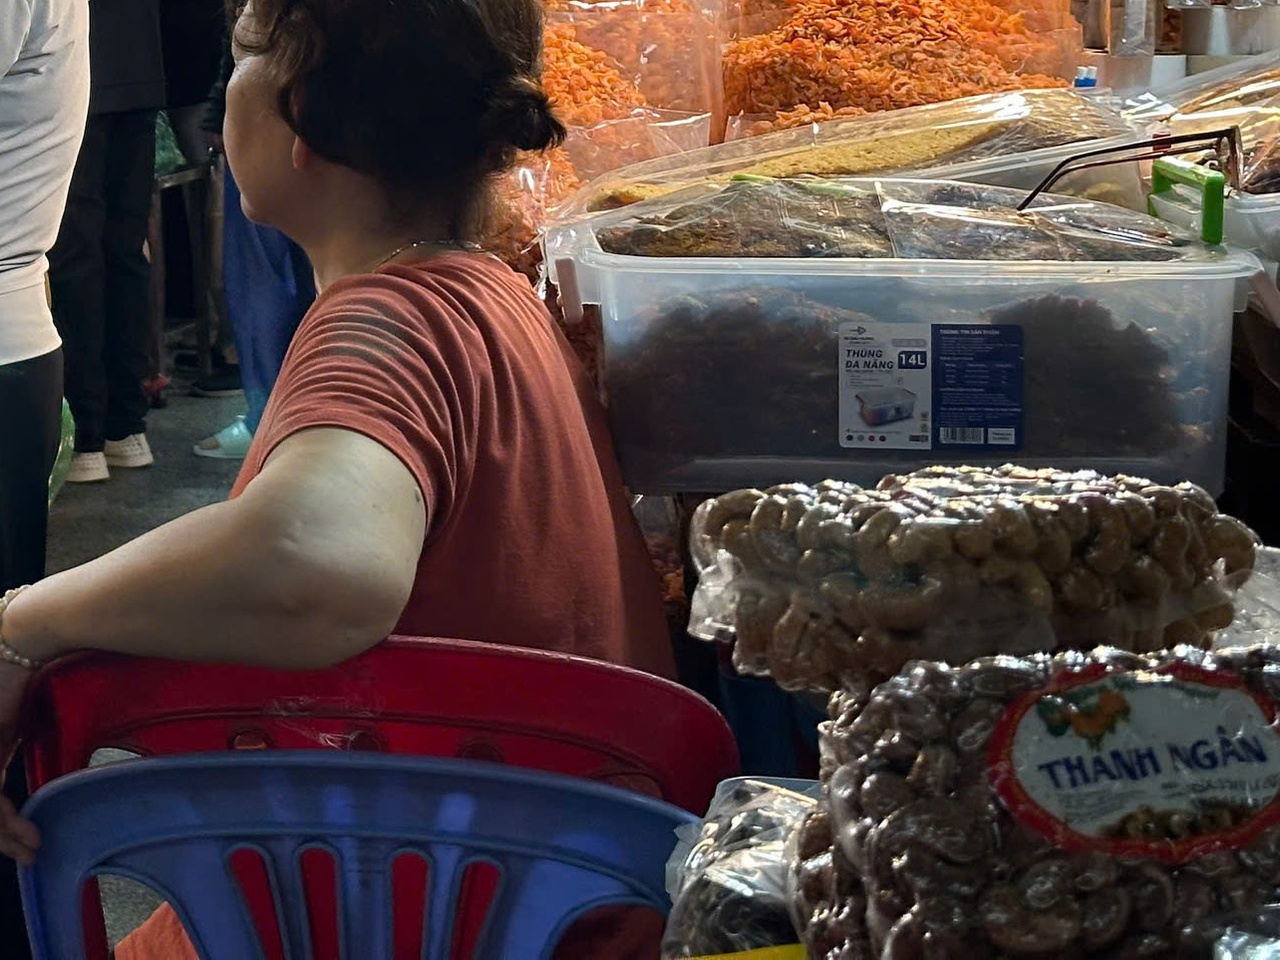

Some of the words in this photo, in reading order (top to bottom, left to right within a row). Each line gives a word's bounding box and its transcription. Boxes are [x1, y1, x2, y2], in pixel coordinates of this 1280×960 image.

[845, 348, 884, 358] THÙNG
[845, 359, 862, 370] ĐA
[863, 358, 895, 370] NĂNG
[899, 353, 926, 366] 14L
[1038, 746, 1162, 789] THANH
[1166, 725, 1268, 773] NGÂN
